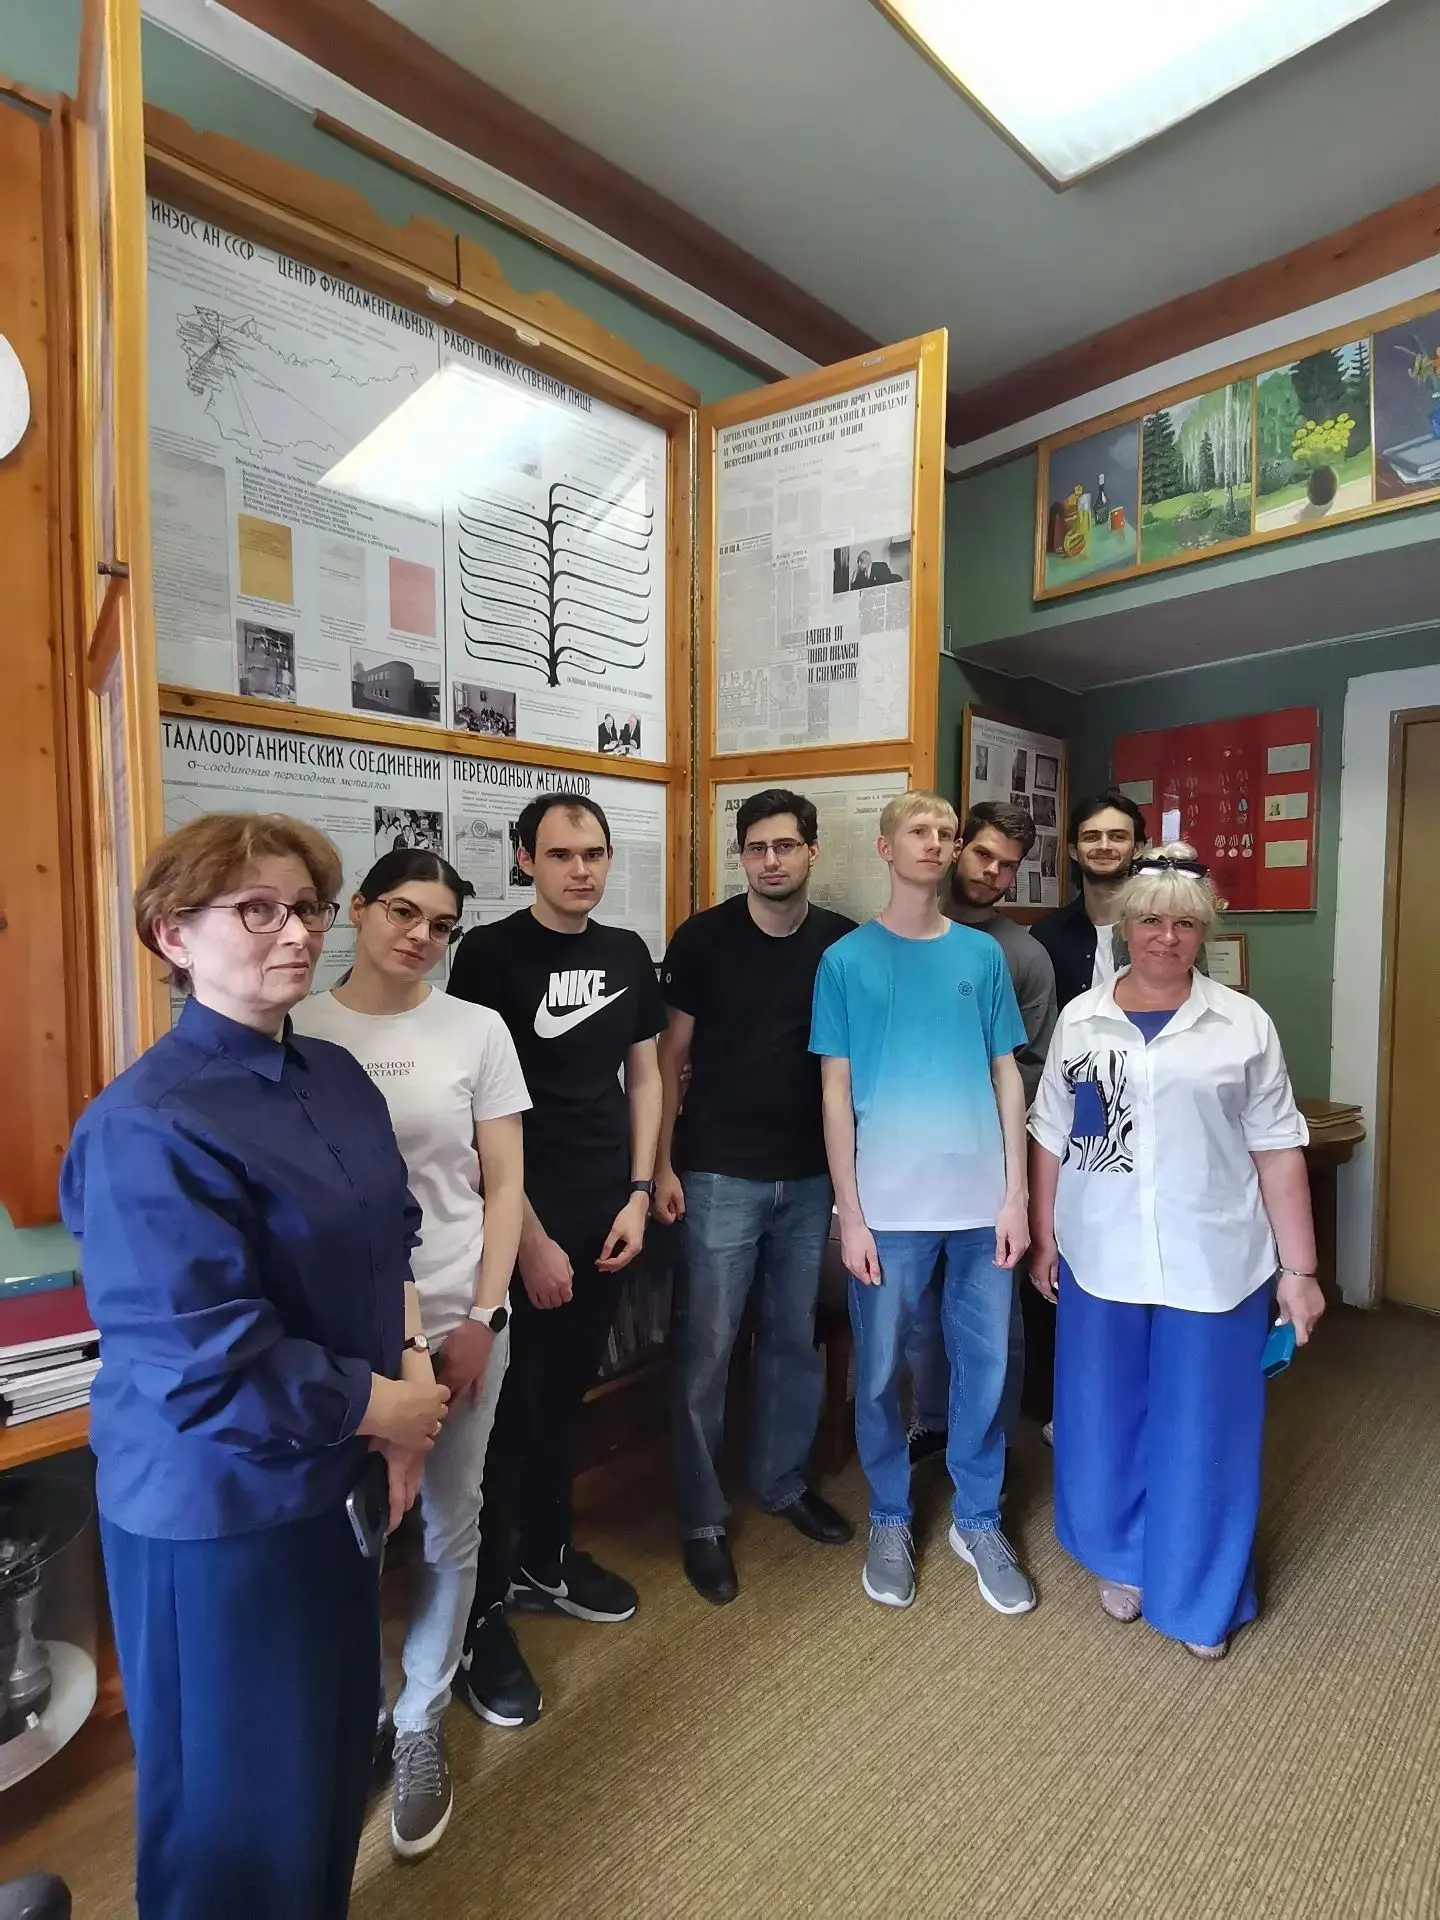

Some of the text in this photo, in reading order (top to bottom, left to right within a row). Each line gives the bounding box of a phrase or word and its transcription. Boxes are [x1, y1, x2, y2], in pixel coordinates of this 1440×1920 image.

[151, 200, 199, 239] ИНЭОС
[202, 223, 220, 249] АН
[224, 235, 255, 261] СССР
[278, 255, 317, 287] ЦЕНТР
[320, 275, 435, 341] ФУНДАМЕНТАЛЬНЫХ
[444, 329, 475, 361] РАБОТ
[478, 345, 492, 366] ПО
[494, 353, 566, 400] ИСКУССТВЕННОЙ
[568, 386, 593, 414] ПИЩЕ
[273, 771, 336, 786] переходных
[339, 778, 391, 791] металлов
[350, 749, 441, 780] СОЕДИНЕНИЙ
[453, 760, 533, 789] ПЕРЕХОДНЫХ
[536, 771, 591, 796] МЕТАЛЛОВ
[549, 970, 606, 1007] NIKE
[366, 1069, 410, 1077] IXTAPES
